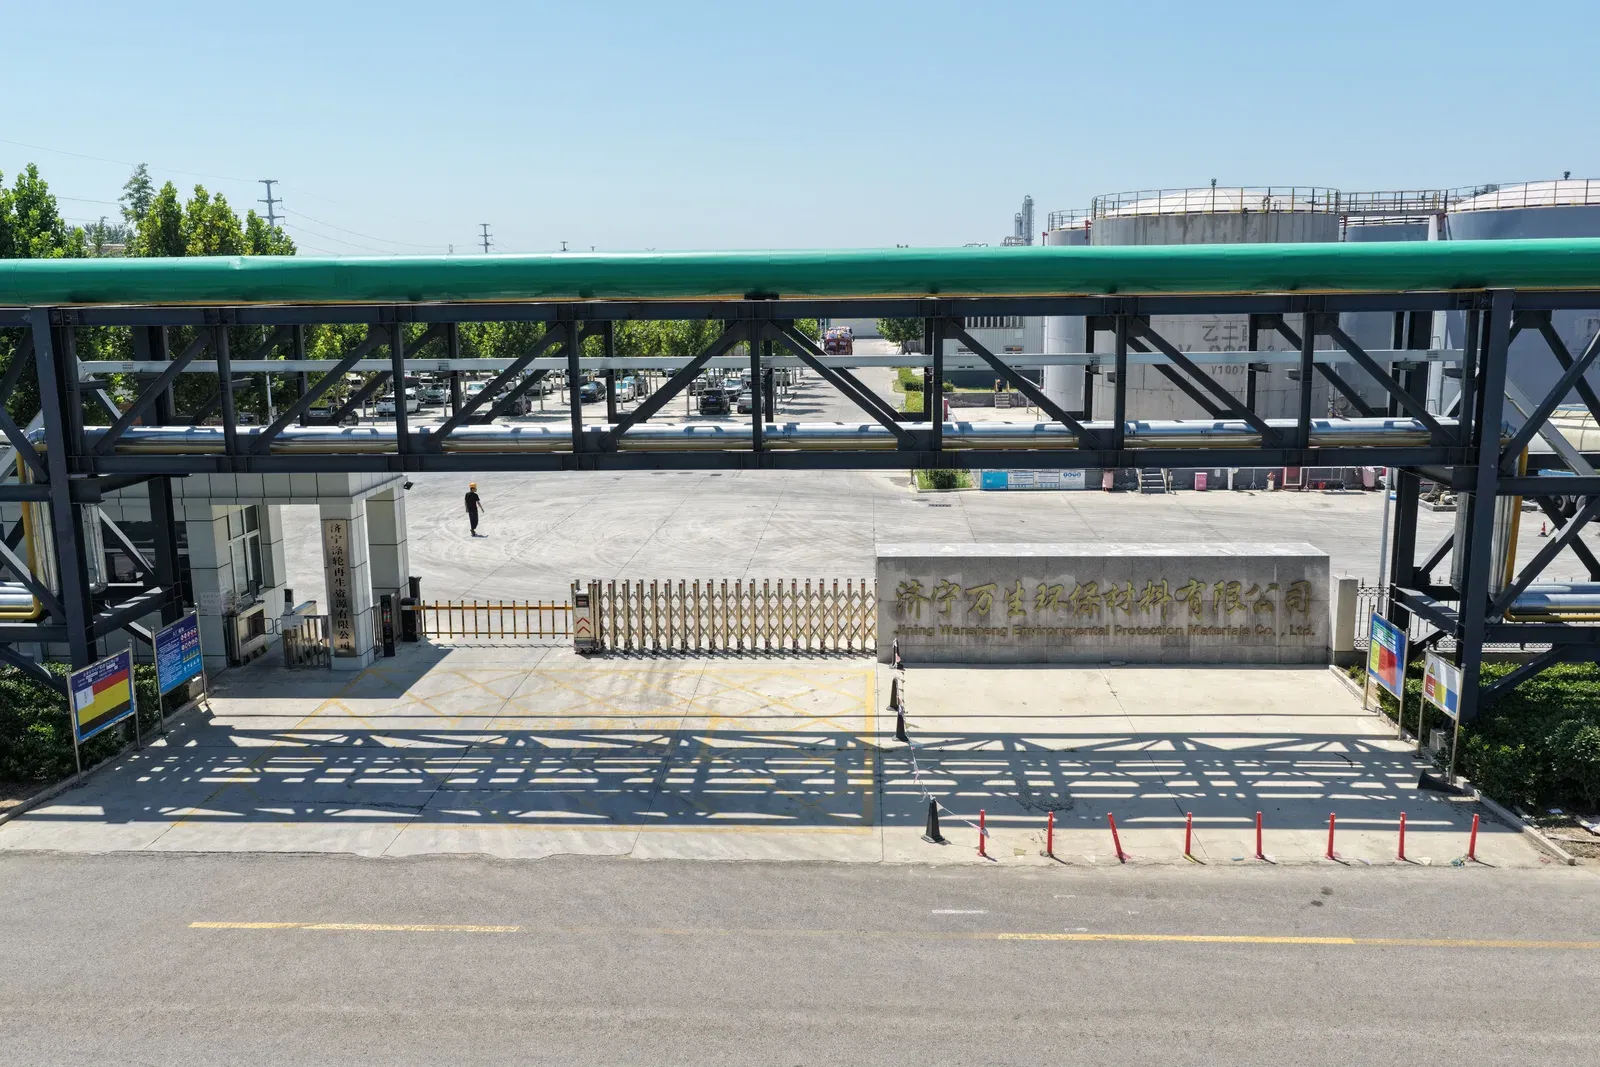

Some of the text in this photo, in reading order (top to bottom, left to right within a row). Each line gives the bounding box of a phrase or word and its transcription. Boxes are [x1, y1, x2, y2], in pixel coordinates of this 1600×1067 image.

[1211, 365, 1245, 375] V1007
[895, 578, 1312, 619] 济宁万生环保材料有限公司
[894, 624, 935, 637] Jining
[939, 624, 1009, 637] Wansheng
[1013, 624, 1110, 636] Environmental
[1114, 624, 1184, 636] Protection
[1188, 624, 1250, 636] Materials
[1290, 624, 1315, 636] Ltd.
